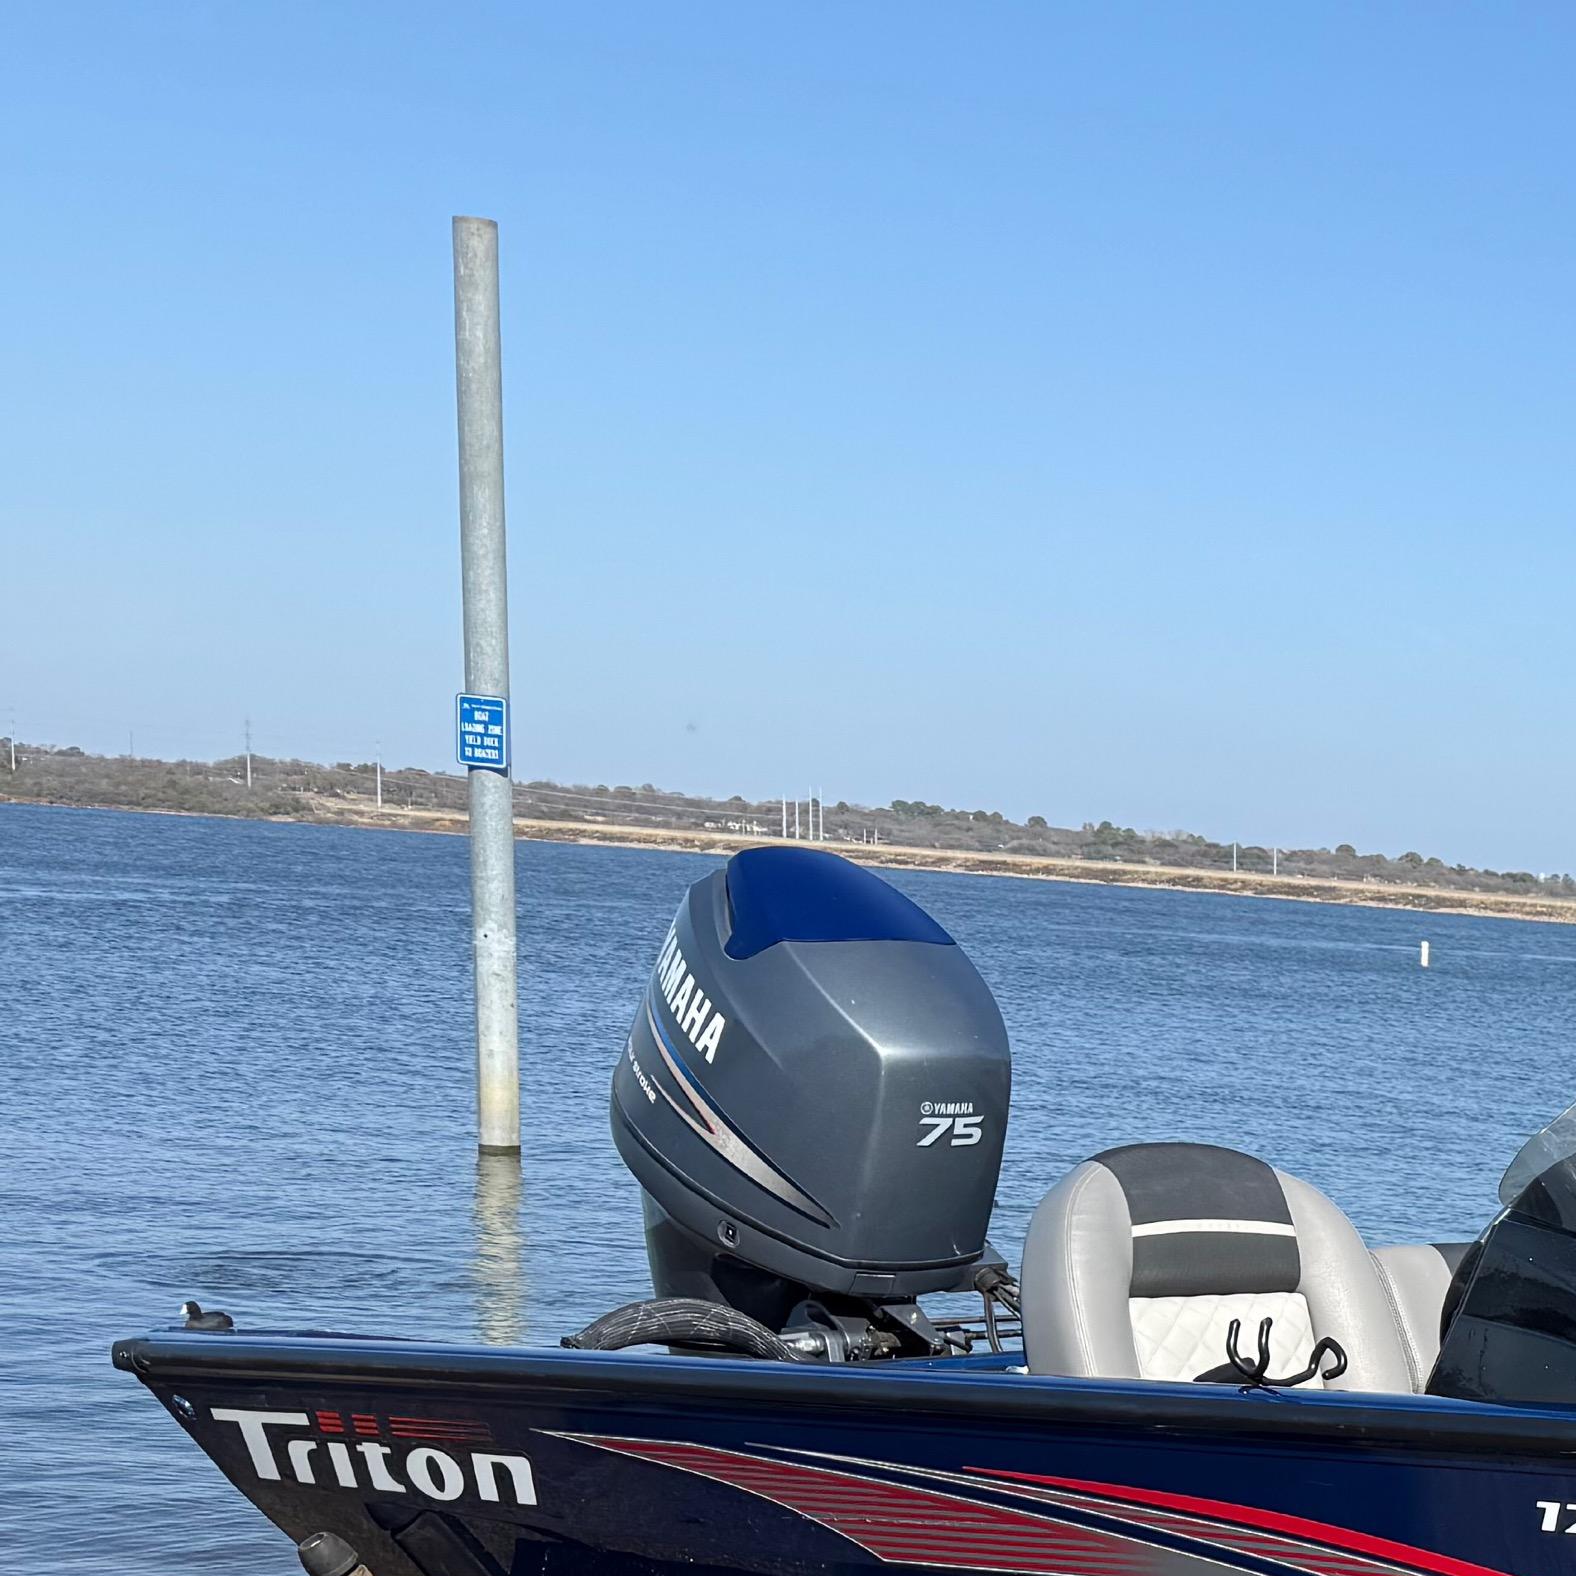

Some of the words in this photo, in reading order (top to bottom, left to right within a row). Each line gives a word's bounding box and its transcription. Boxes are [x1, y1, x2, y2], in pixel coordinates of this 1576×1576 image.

[934, 1102, 973, 1115] YAMAHA
[916, 1115, 985, 1147] 75
[210, 1406, 538, 1507] Triton
